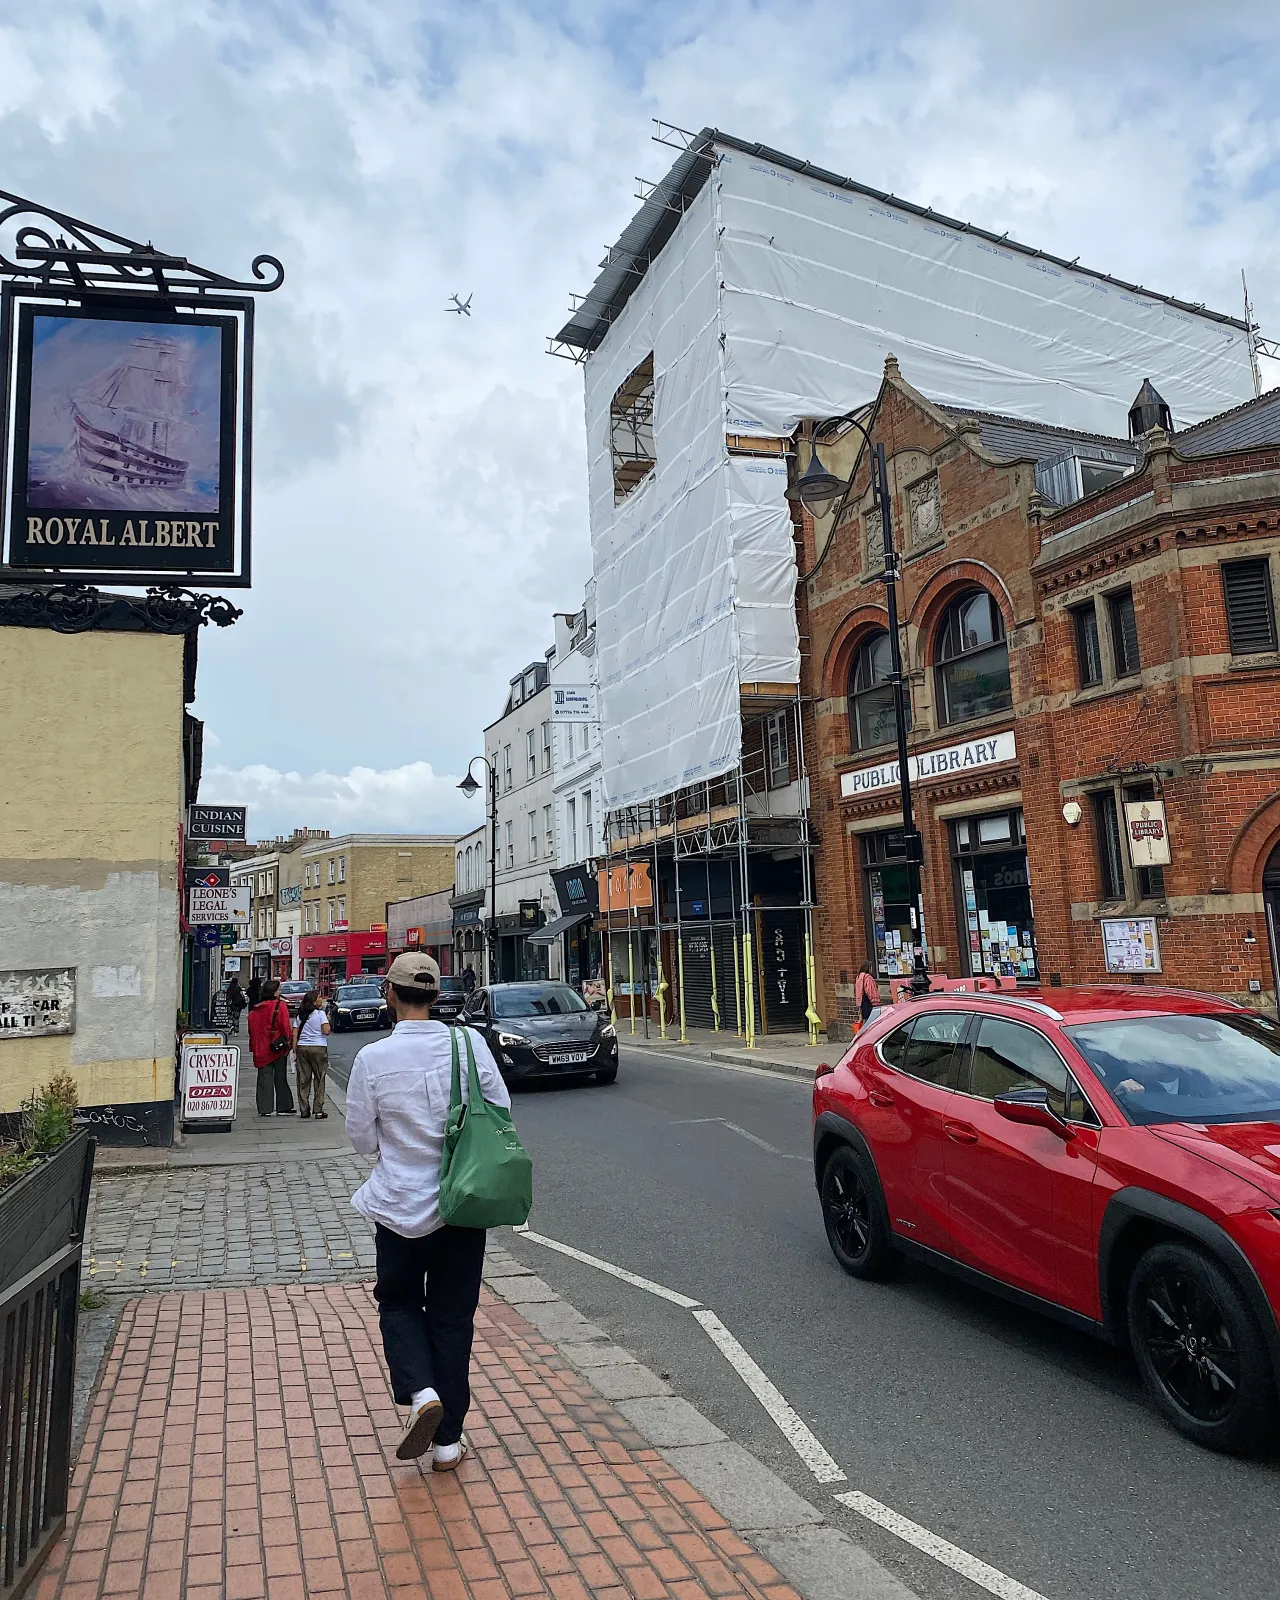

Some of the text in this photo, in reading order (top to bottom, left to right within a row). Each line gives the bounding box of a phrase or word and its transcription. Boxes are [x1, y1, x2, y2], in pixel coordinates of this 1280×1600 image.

[26, 516, 220, 548] ROYAL ALBERT
[919, 740, 998, 776] LIBRARY
[194, 810, 243, 821] INDIAN
[191, 823, 244, 834] CUISINE
[1135, 821, 1158, 829] PUBLIC
[1134, 828, 1161, 836] LIBRARY
[623, 872, 643, 892] CINIC
[192, 887, 237, 899] LEONE'S
[192, 900, 228, 911] LEGAL
[191, 912, 229, 922] SERVICES
[189, 1053, 235, 1068] CRYSTAL
[196, 1068, 228, 1083] NAILS
[191, 1087, 230, 1097] OPEN
[187, 1099, 233, 1112] 020 8670 3221
